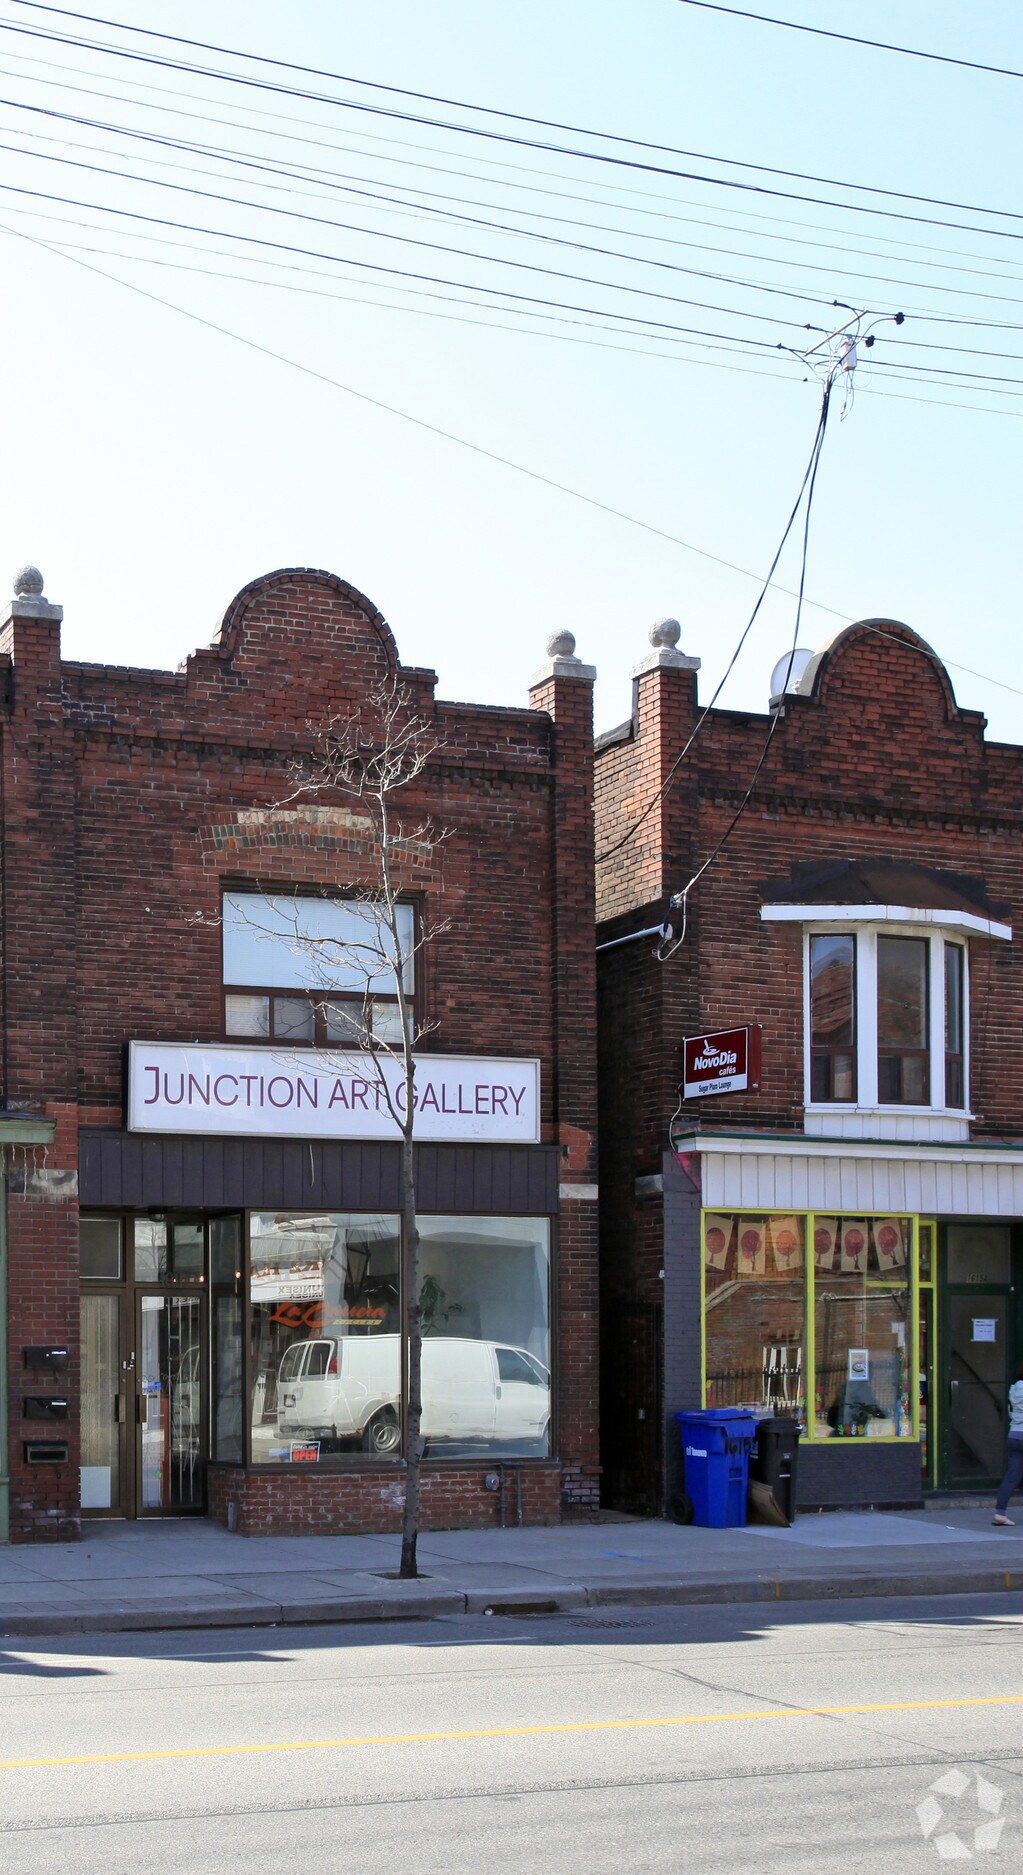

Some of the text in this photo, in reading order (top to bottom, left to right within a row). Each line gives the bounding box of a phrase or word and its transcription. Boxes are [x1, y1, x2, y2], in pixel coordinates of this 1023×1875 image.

[694, 1051, 736, 1070] NovoDia
[719, 1066, 736, 1075] cafés
[144, 1066, 527, 1115] JUNCTION ART GALLERY
[699, 1085, 708, 1093] Sugar
[719, 1081, 731, 1089] Lounge
[292, 1449, 317, 1461] OPEN
